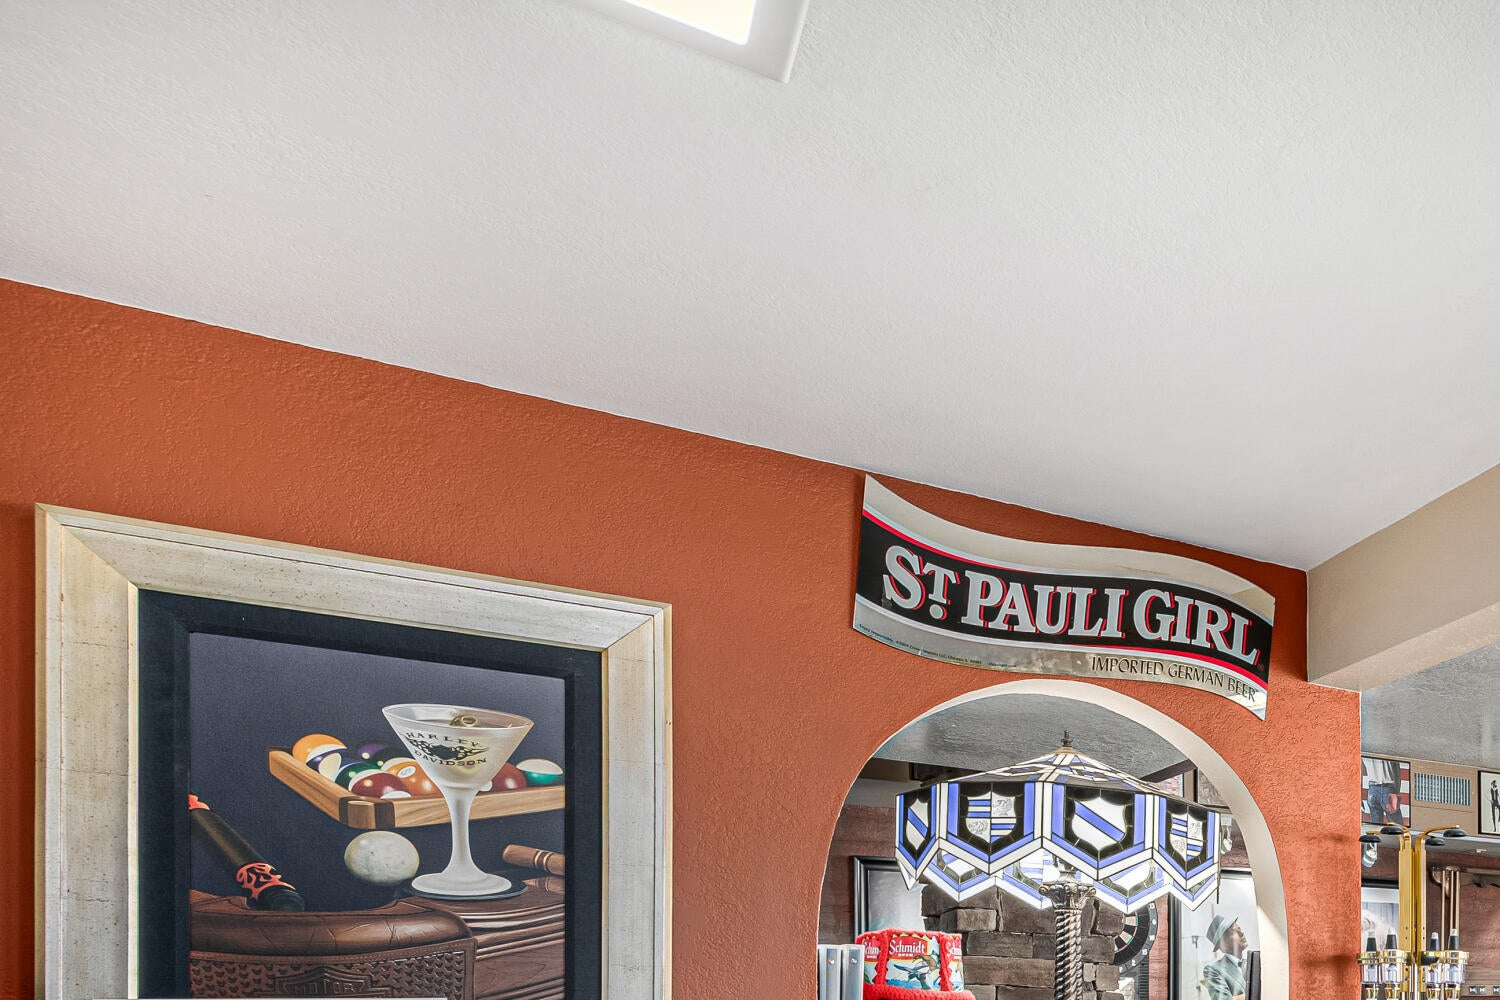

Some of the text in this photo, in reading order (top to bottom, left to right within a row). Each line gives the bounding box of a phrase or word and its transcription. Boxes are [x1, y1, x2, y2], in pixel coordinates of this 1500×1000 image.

[960, 570, 1131, 640] PAULI
[1133, 588, 1262, 667] GIRL
[1092, 656, 1257, 702] IMPORTED GERMAN BEER
[405, 732, 482, 748] HARLEY
[415, 750, 487, 767] DAVIDSON
[889, 940, 926, 955] Schmidt
